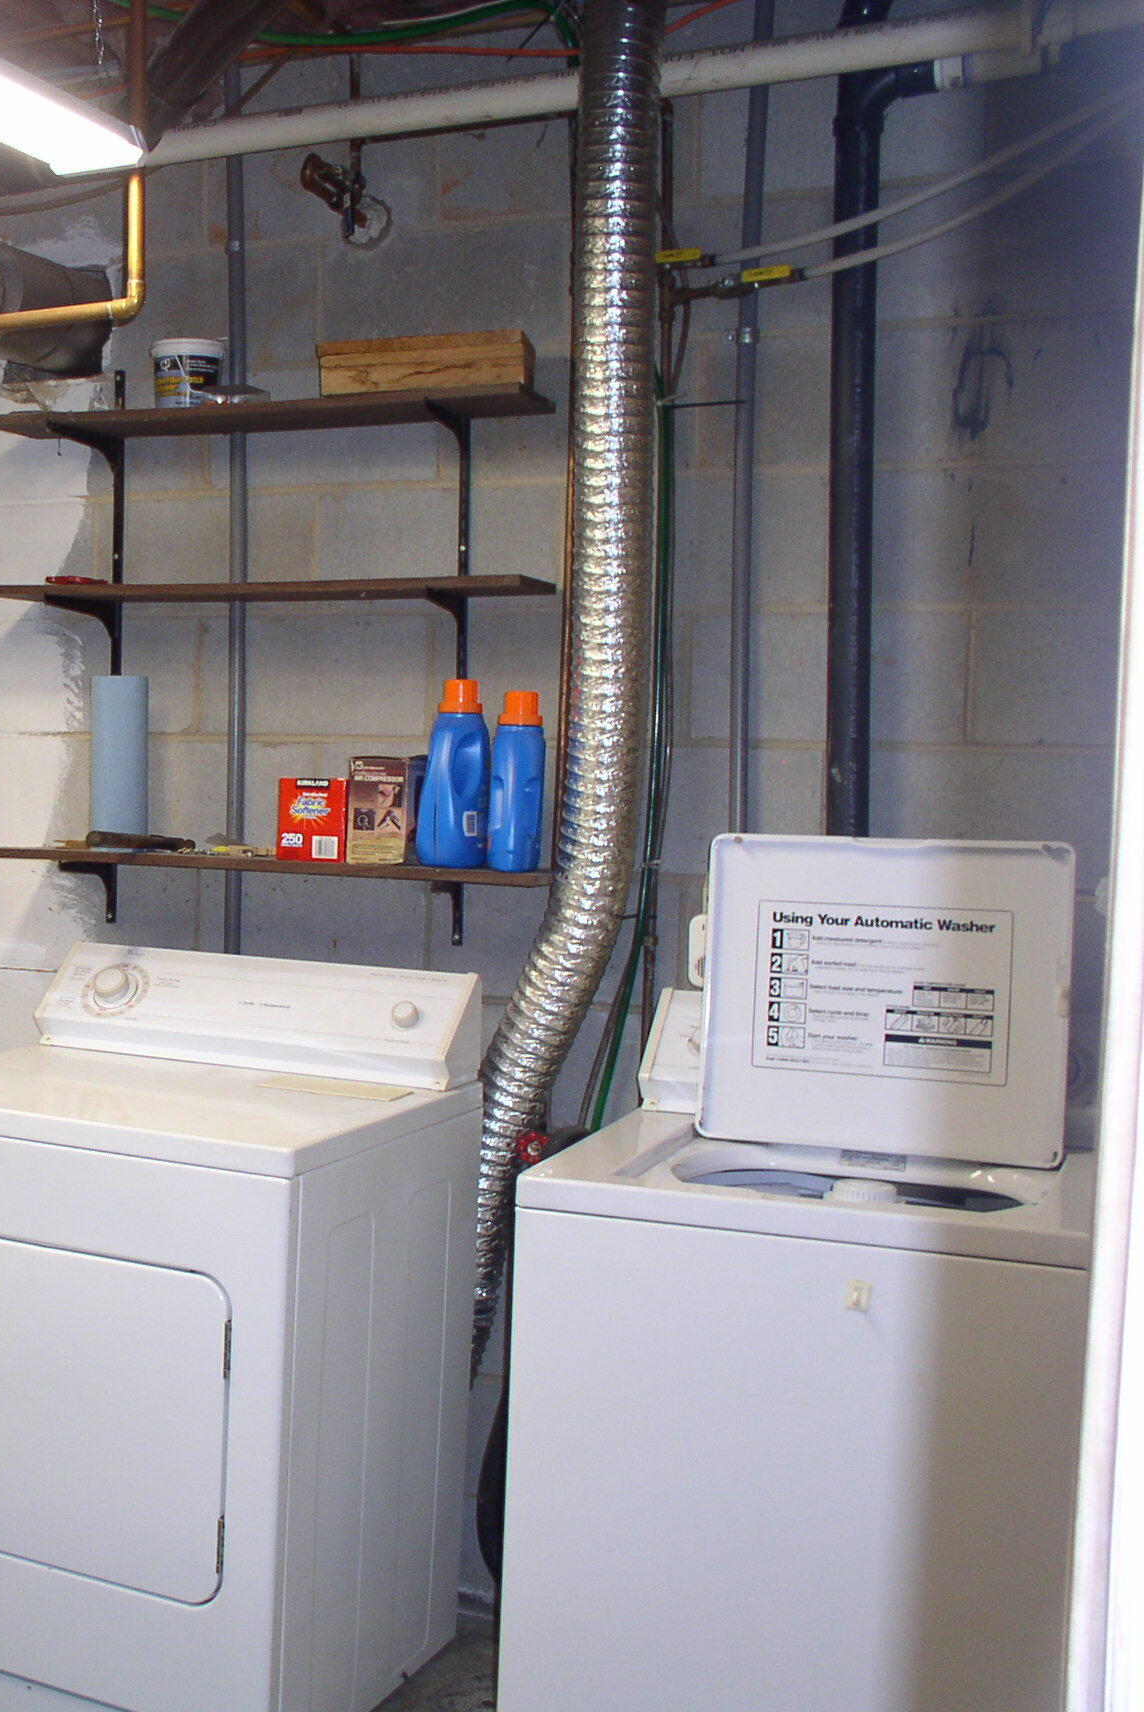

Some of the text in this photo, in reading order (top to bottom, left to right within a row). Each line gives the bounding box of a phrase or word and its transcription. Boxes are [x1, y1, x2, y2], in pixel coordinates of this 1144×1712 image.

[291, 805, 330, 815] Softener
[297, 797, 325, 805] Fabric
[773, 912, 996, 934] Using Your Automatic Washer
[773, 929, 782, 949] 1
[771, 954, 782, 973] 2
[770, 978, 780, 997] 3
[769, 1003, 779, 1021] 4
[768, 1026, 778, 1046] 5
